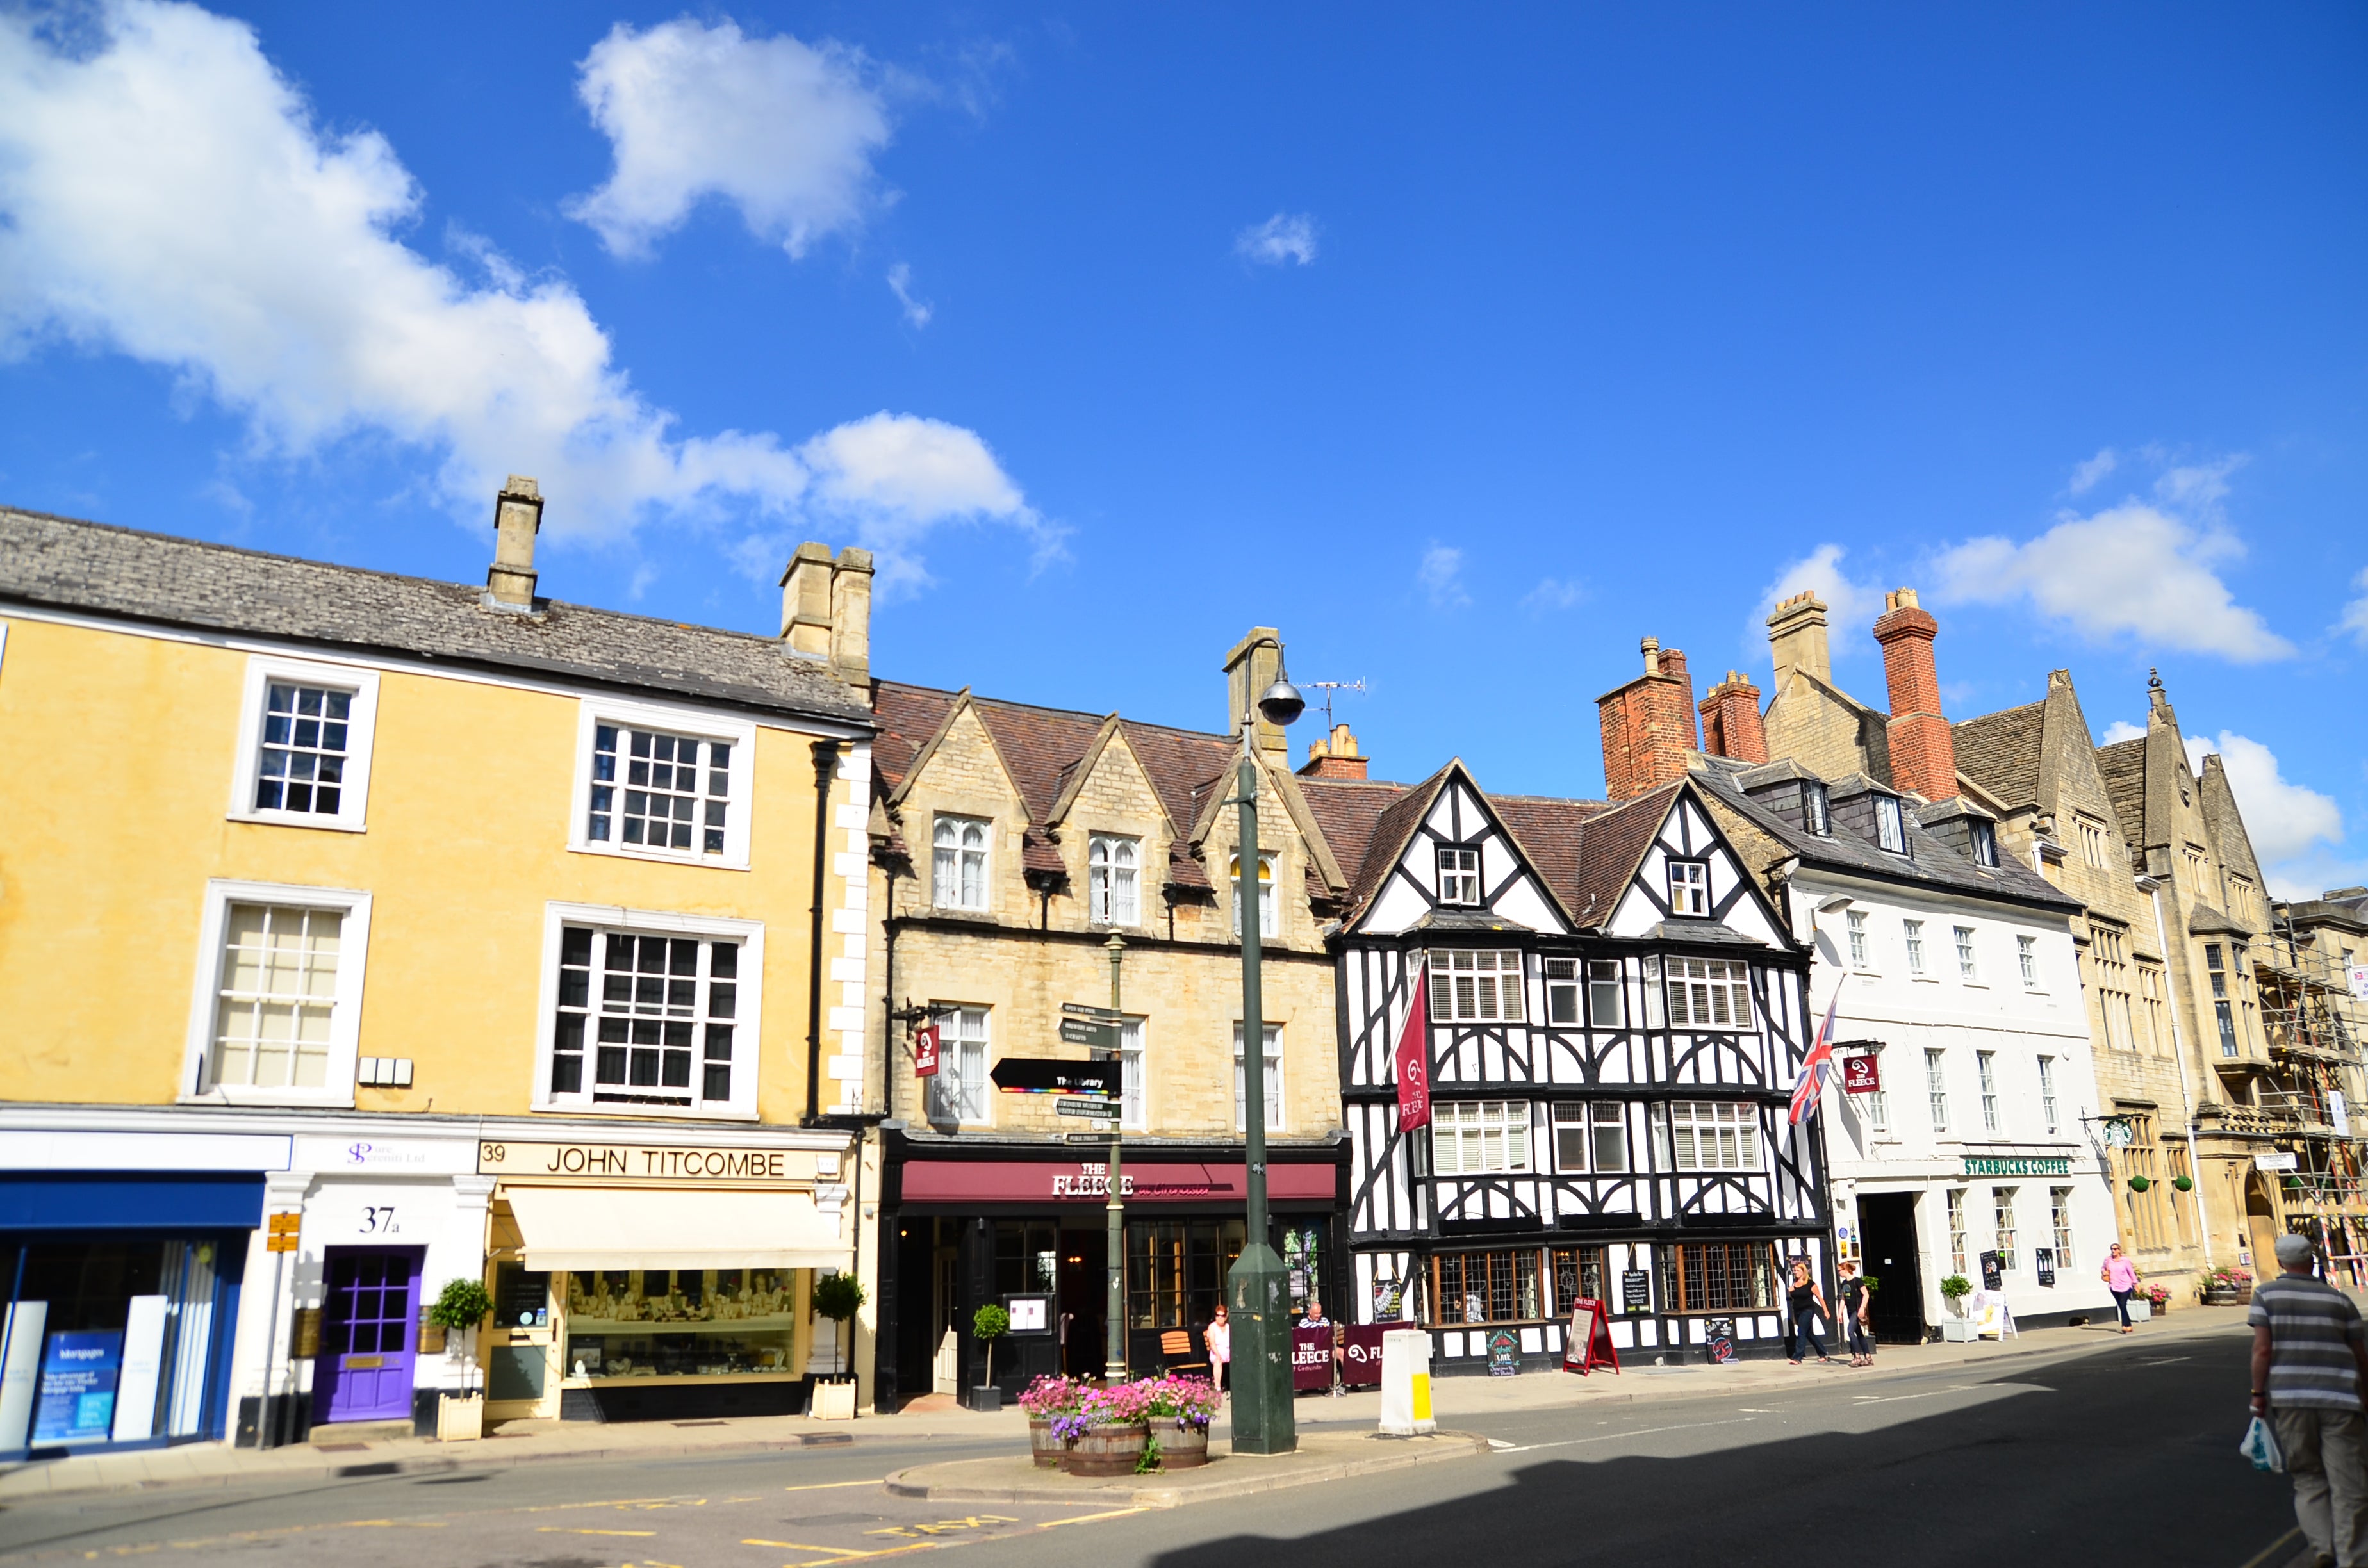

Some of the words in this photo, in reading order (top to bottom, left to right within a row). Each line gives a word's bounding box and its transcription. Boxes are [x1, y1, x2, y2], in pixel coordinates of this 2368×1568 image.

[1057, 1076, 1072, 1086] The
[1074, 1077, 1103, 1088] Library
[1848, 1077, 1875, 1087] FLEECE
[483, 1144, 505, 1162] 39
[547, 1147, 627, 1174] JOHN
[641, 1150, 784, 1177] TITCOMBE
[1081, 1163, 1106, 1175] THE
[1964, 1159, 2028, 1175] STARBUCKS
[2031, 1159, 2069, 1174] COFFEE
[359, 1207, 399, 1234] 37a
[1299, 1343, 1315, 1351] THE
[59, 1348, 105, 1360] Mortgages
[1292, 1350, 1329, 1364] LEECE
